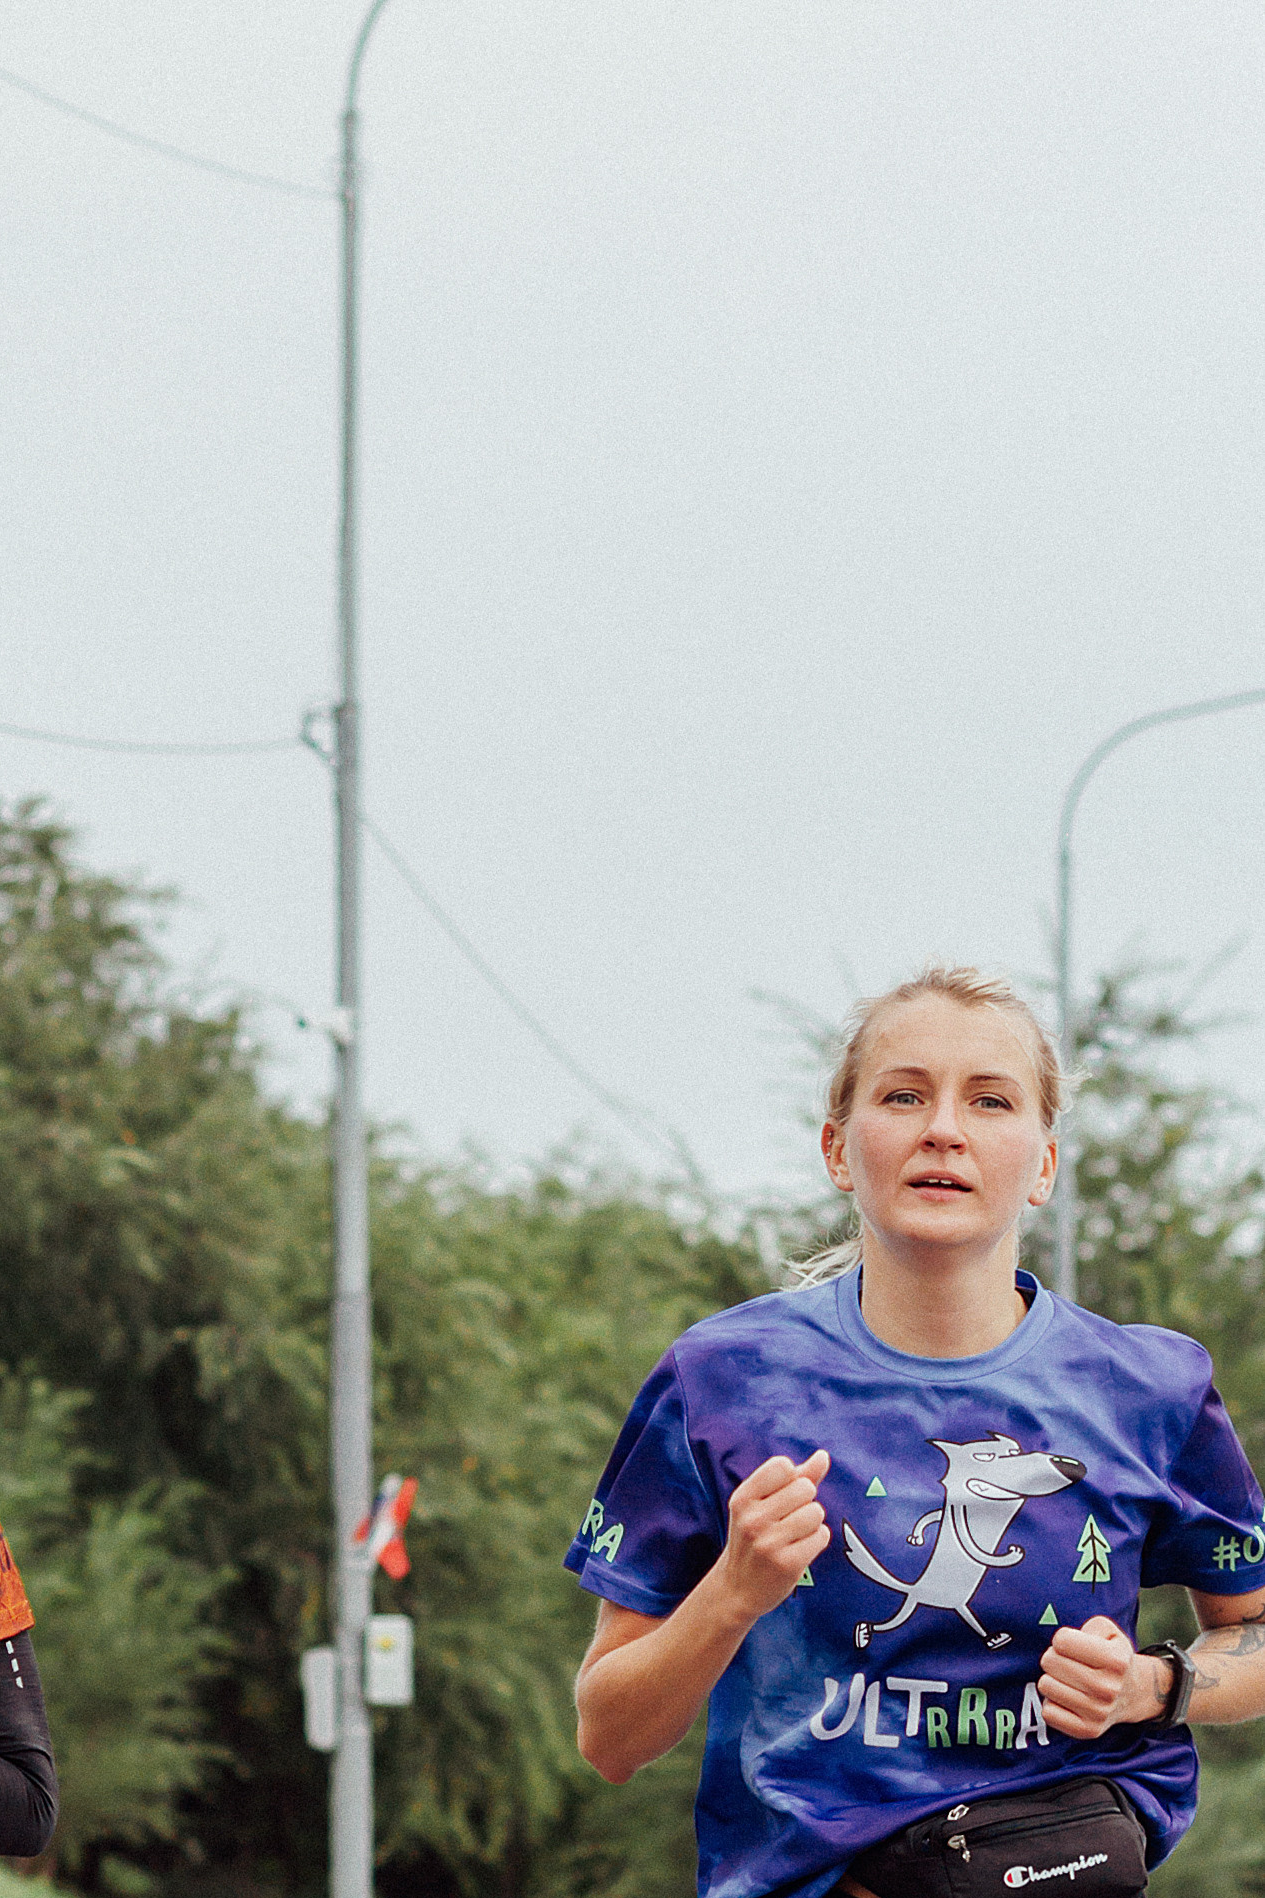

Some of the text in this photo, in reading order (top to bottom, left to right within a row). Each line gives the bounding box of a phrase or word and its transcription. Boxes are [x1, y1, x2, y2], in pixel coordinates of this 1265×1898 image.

[1212, 1524, 1265, 1572] #U
[809, 1672, 1050, 1750] ULTRRRA
[1003, 1853, 1108, 1889] Champion
